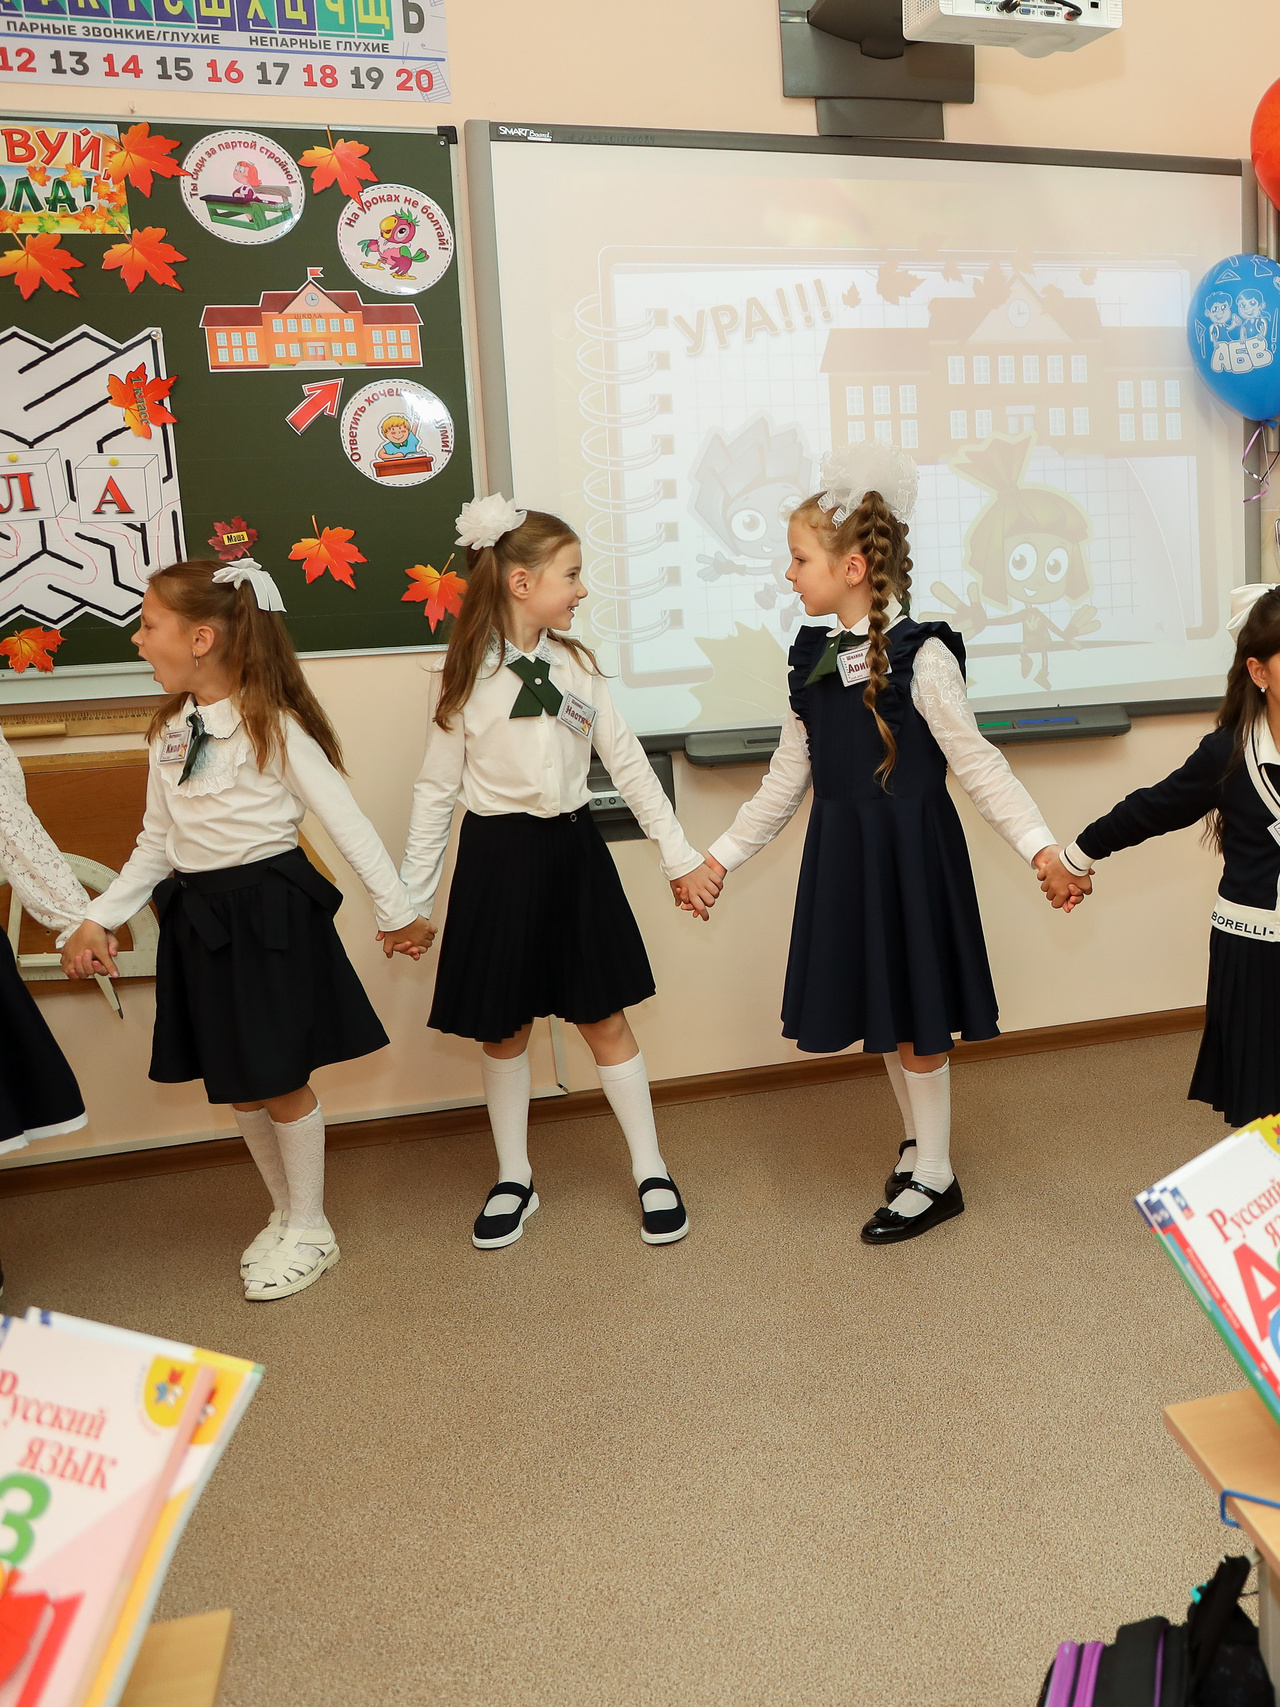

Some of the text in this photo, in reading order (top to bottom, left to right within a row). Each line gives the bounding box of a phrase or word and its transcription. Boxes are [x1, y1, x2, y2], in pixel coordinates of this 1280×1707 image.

[6, 20, 220, 45] ПАРНЫЕ ЗВОНКИЕ/ГЛУХИЕ
[249, 35, 390, 53] НЕПАРНЫЕ ГЛУХИЕ
[0, 46, 433, 92] 12 13 14 15 16 17 18 19 20
[499, 125, 530, 136] SMART
[189, 140, 297, 198] Ты сиди за партой стройно!
[345, 194, 449, 251] На уроках не болтай!
[673, 278, 832, 355] УРА!!!
[1211, 338, 1273, 374] АБВ
[133, 388, 150, 426] класс
[348, 405, 367, 462] Ответить
[92, 475, 135, 514] А
[226, 534, 246, 543] Маша
